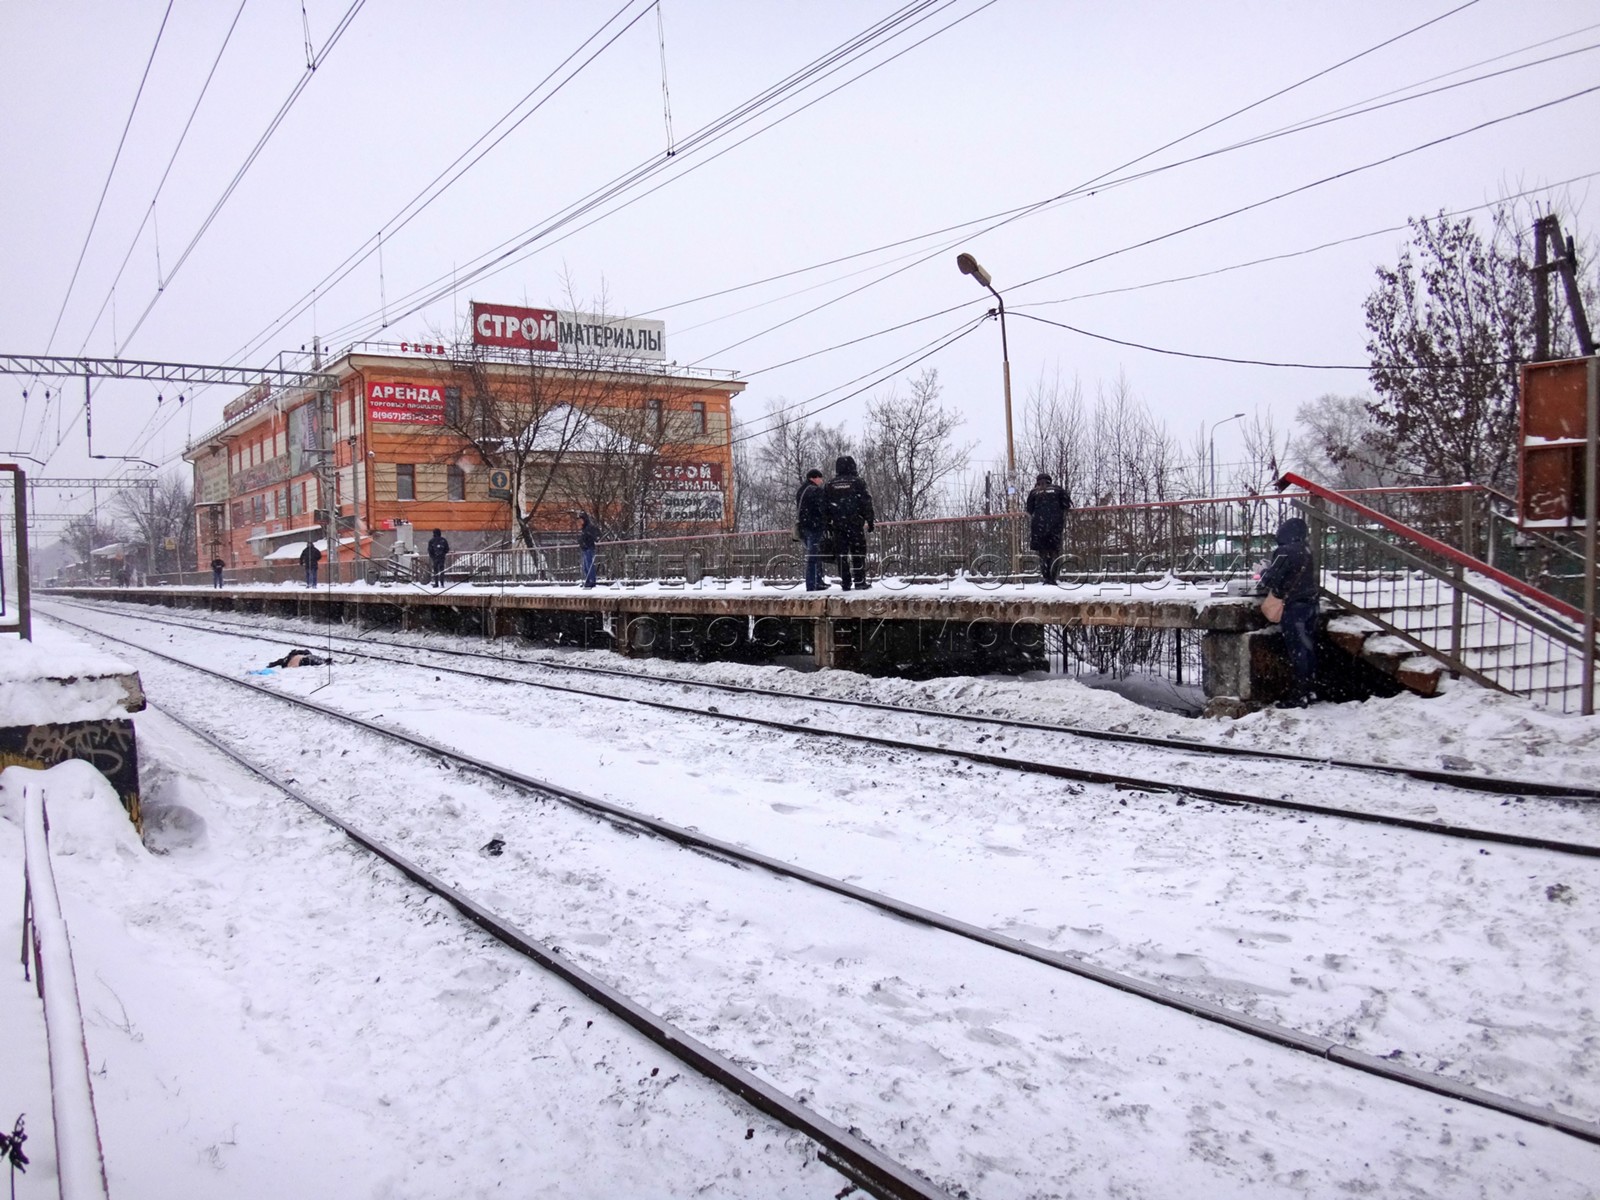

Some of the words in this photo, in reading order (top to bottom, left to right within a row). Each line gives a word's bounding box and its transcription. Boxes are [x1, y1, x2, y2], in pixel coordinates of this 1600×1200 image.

[477, 313, 557, 343] СТРОЙ
[559, 321, 662, 352] МАТЕРИАЛЫ
[400, 342, 445, 355] CLUB
[371, 385, 442, 403] АРЕНДА
[652, 463, 712, 479] СТРОЙ
[648, 480, 721, 491] АТЕРИАЛЫ
